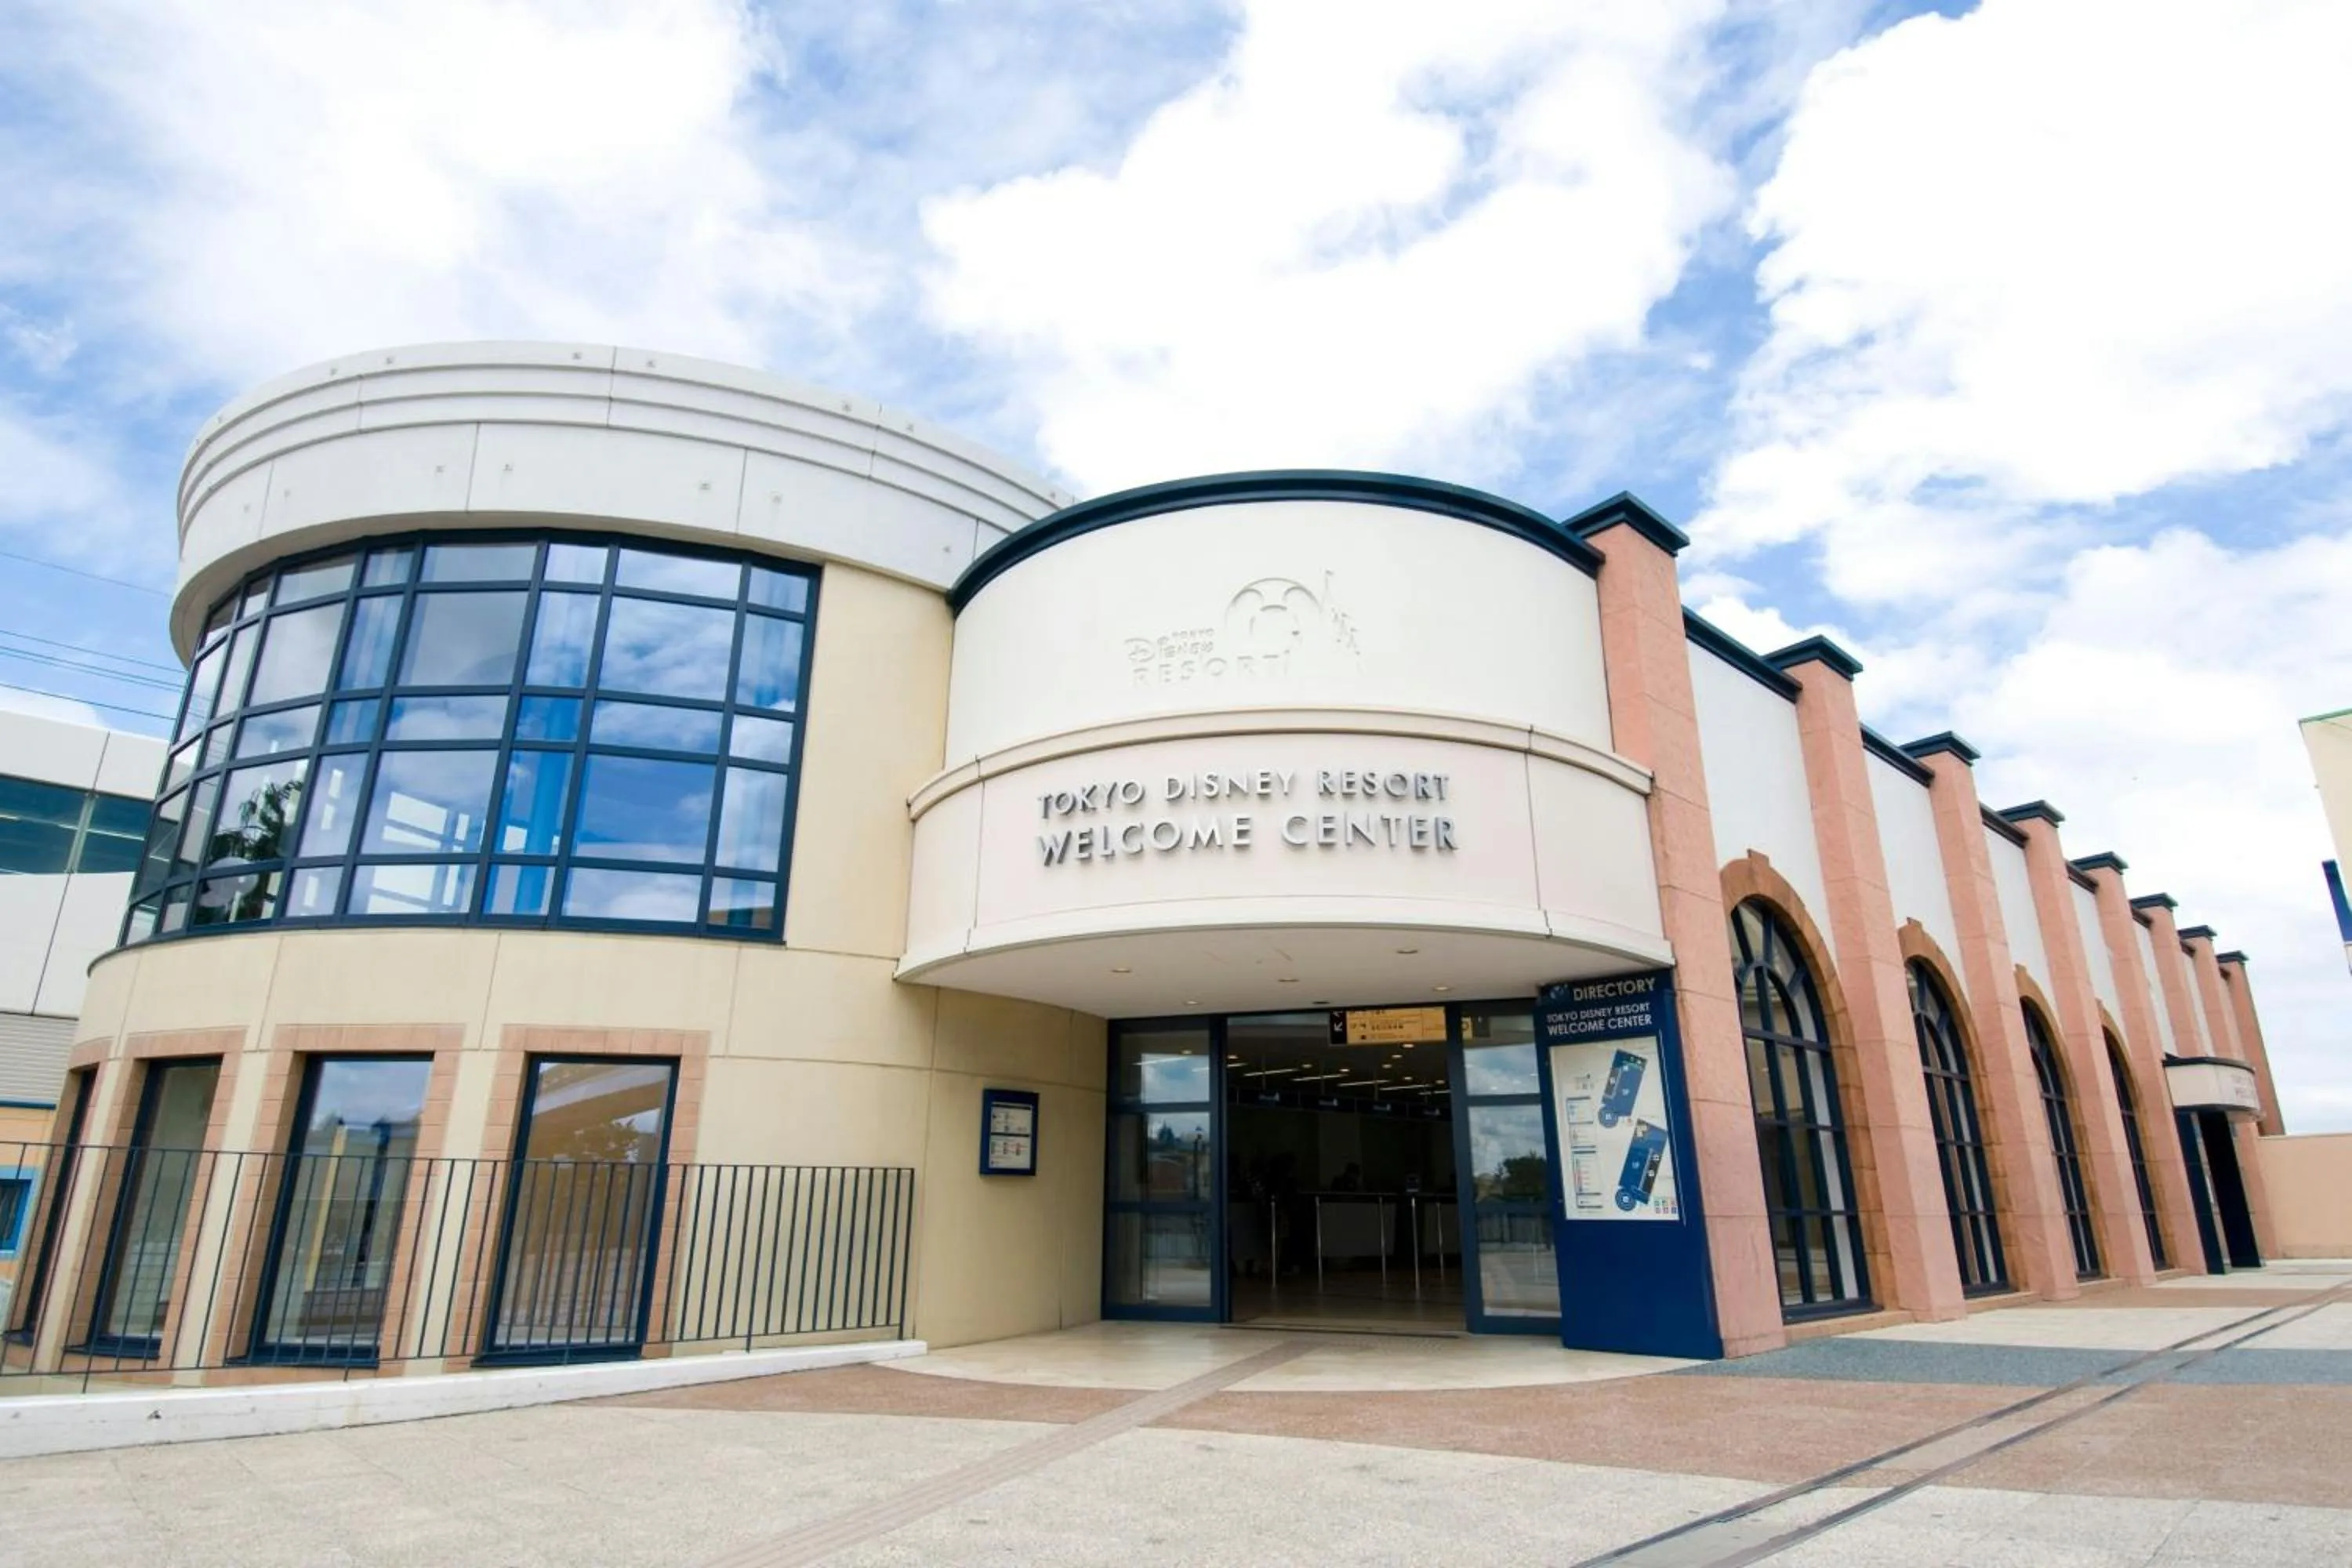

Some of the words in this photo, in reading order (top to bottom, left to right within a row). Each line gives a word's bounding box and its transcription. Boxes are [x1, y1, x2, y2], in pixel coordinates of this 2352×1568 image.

[1037, 779, 1145, 819] TOKYO
[1164, 769, 1295, 801] DISNEY
[1317, 770, 1450, 803] RESORT
[1037, 816, 1252, 867] WELCOME
[1280, 813, 1458, 852] CENTER
[1573, 978, 1656, 1001] DIRECTORY
[1546, 1011, 1578, 1023] TOKYO
[1580, 1006, 1613, 1018] DISNEY
[1615, 1002, 1650, 1014] RESORT
[1547, 1019, 1605, 1036] WELCOME
[1608, 1014, 1653, 1029] CENTER
